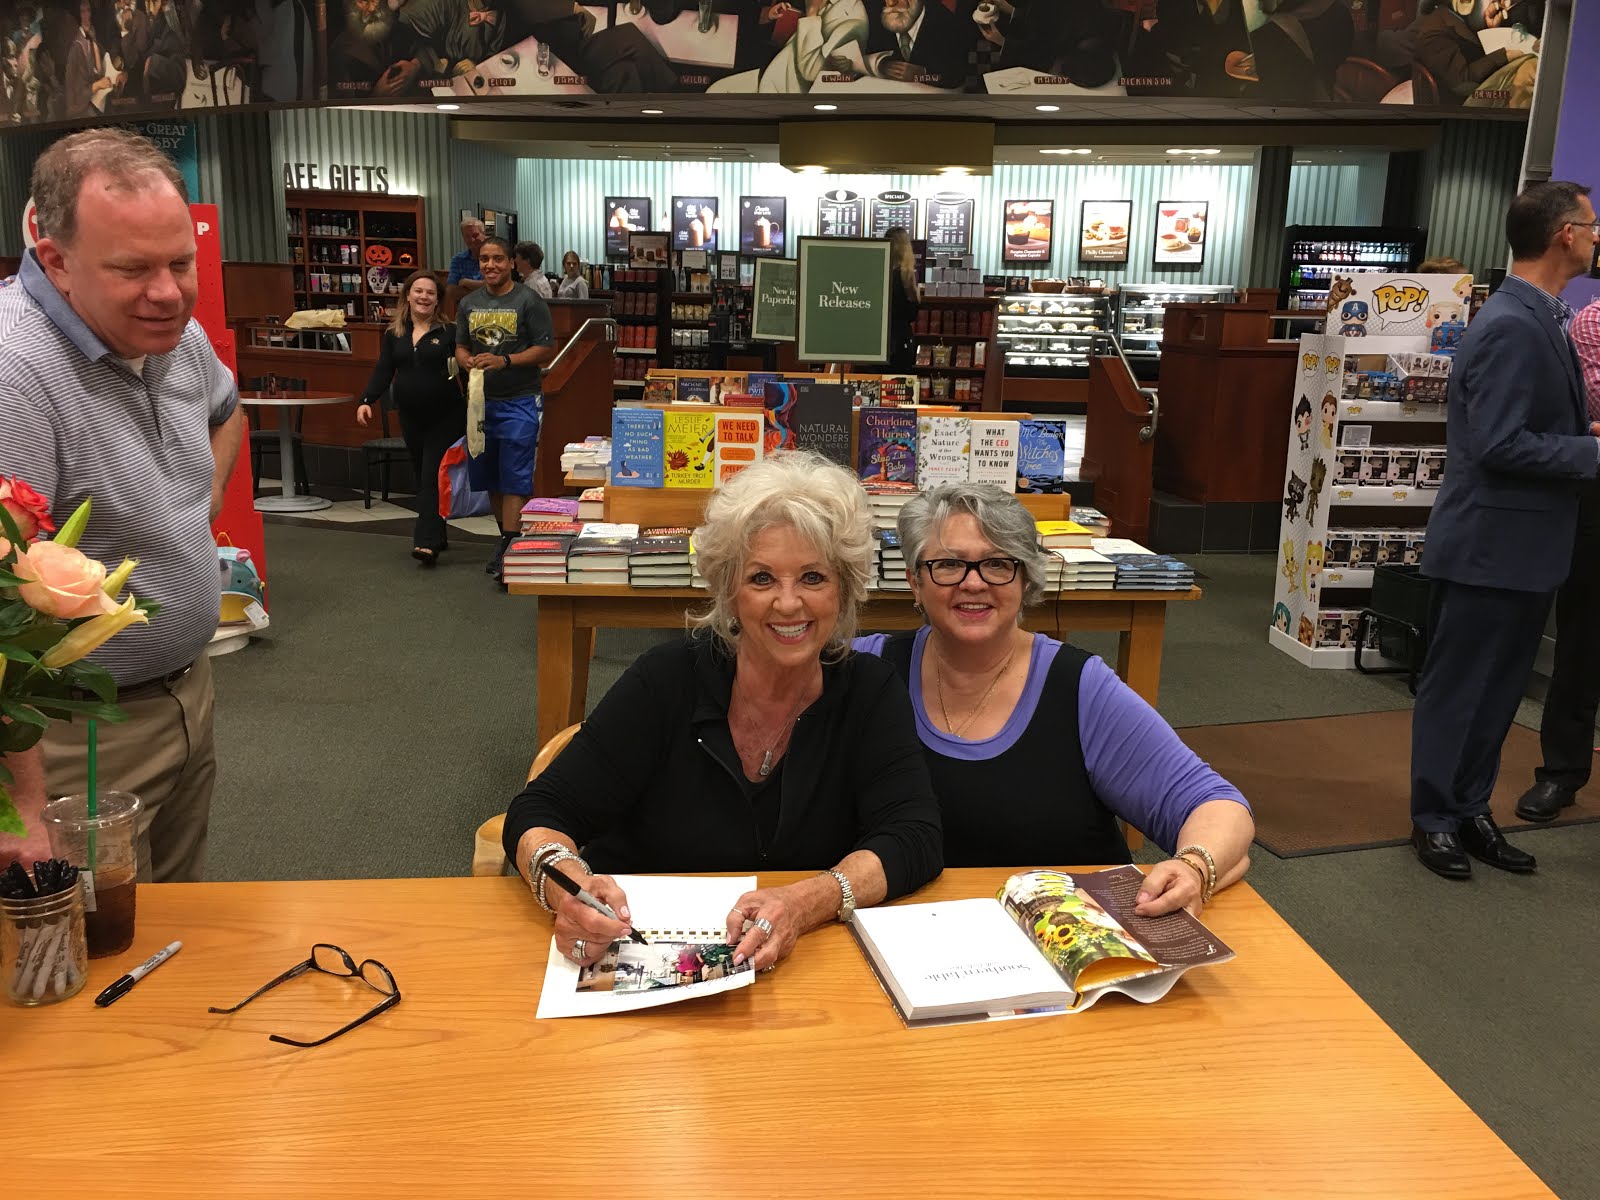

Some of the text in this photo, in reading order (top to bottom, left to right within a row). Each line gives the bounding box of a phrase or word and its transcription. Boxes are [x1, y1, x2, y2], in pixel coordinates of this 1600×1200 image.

[490, 78, 514, 86] ELIOT
[554, 76, 586, 84] JAMES
[682, 75, 708, 84] WILDE
[914, 74, 940, 82] SHAW
[1036, 76, 1069, 84] HARDY
[1120, 77, 1172, 86] DICKINSON
[1474, 90, 1508, 98] ORWELL
[146, 122, 187, 136] GREAT
[284, 162, 390, 192] AFE GIFTS
[772, 286, 788, 295] New
[831, 282, 859, 294] New
[762, 293, 796, 307] Paperba
[818, 294, 872, 309] Releases
[1372, 285, 1430, 314] POP!
[722, 422, 756, 431] WE NEED
[866, 415, 914, 428] Charlaine
[668, 424, 708, 434] MEIER
[800, 424, 848, 434] NATURAL
[870, 428, 910, 439] Harris
[934, 428, 957, 437] Exact
[1038, 426, 1064, 440] Beaton
[723, 432, 754, 442] TO TALK
[800, 434, 849, 443] WONDERS
[929, 454, 960, 462] Wrongs
[888, 462, 906, 473] Baby
[964, 964, 1031, 976] Southern
